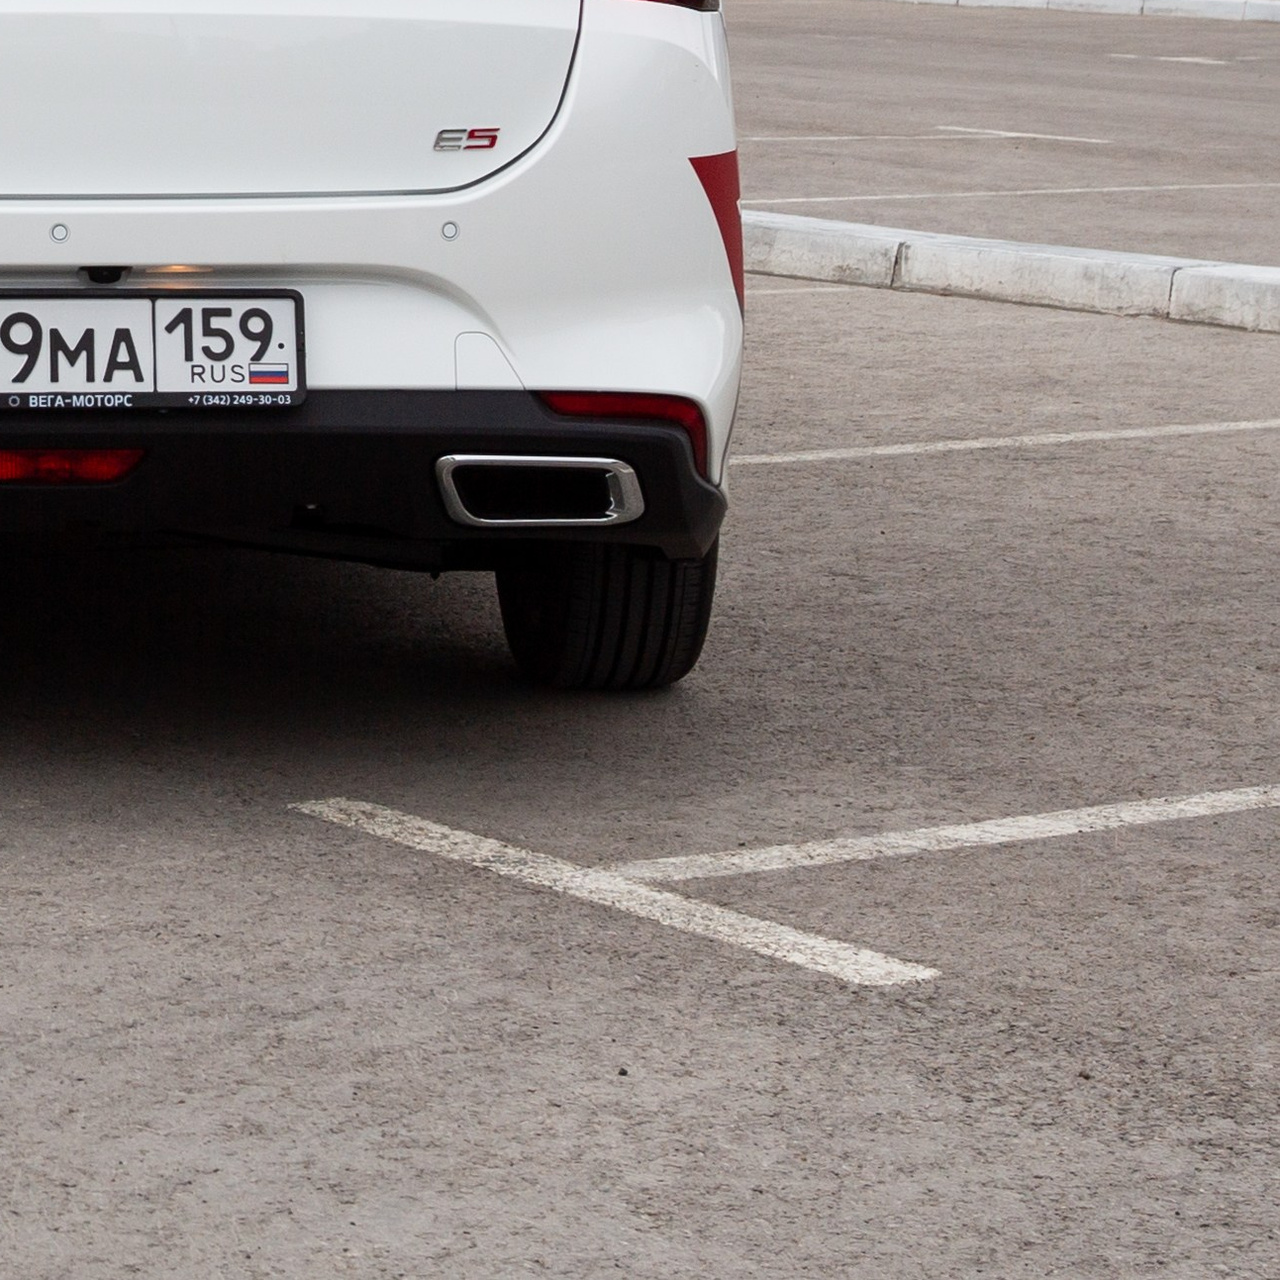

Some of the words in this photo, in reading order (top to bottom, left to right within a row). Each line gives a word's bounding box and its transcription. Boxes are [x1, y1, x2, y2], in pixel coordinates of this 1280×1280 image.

[164, 307, 274, 363] 159
[190, 364, 246, 384] RUS
[28, 394, 133, 408] ВЕГА-МОТОРС
[187, 394, 201, 405] +7
[203, 394, 231, 406] (342)
[232, 394, 292, 405] 249-30-03
